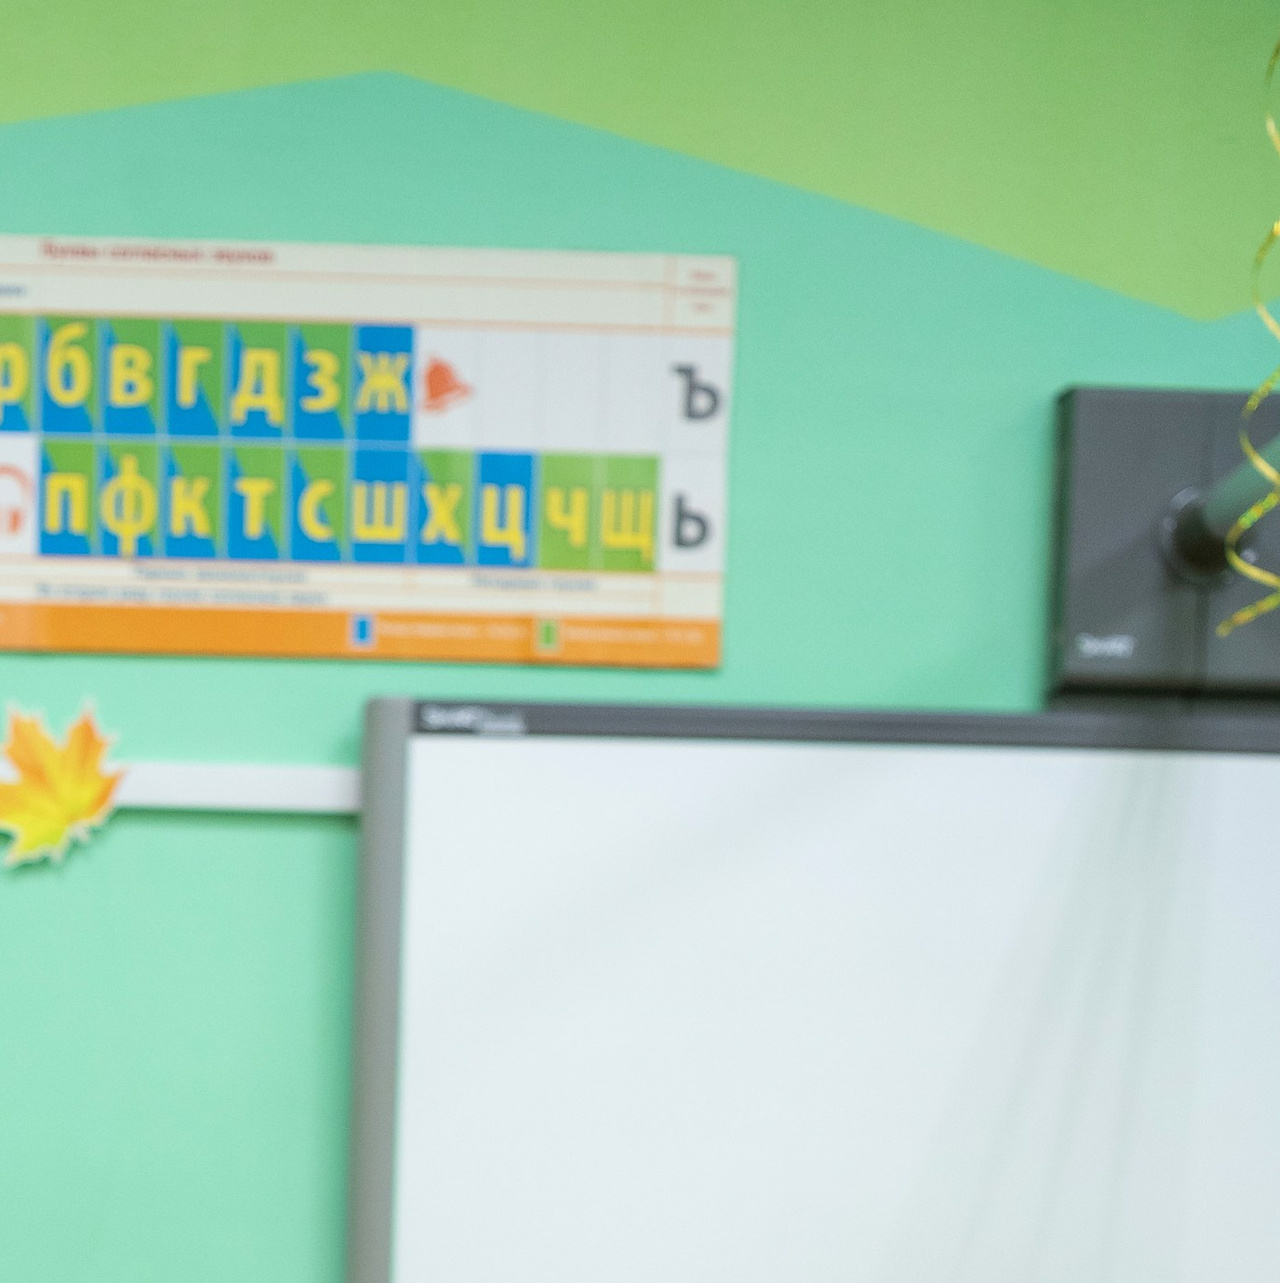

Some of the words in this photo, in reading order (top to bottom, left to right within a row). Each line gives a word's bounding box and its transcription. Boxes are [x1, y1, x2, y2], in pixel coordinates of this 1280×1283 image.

[47, 322, 91, 406] б
[110, 345, 153, 406] в
[178, 347, 211, 408] г
[231, 349, 285, 424] д
[302, 349, 340, 411] з
[357, 352, 409, 412] ж
[45, 472, 89, 533] п
[102, 454, 157, 559] ф
[170, 477, 211, 536] к
[236, 478, 275, 539] т
[300, 479, 334, 540] с
[352, 481, 407, 543] ш
[424, 482, 463, 543] х
[482, 484, 527, 560] ц
[545, 487, 588, 547] ч
[601, 489, 656, 563] щ
